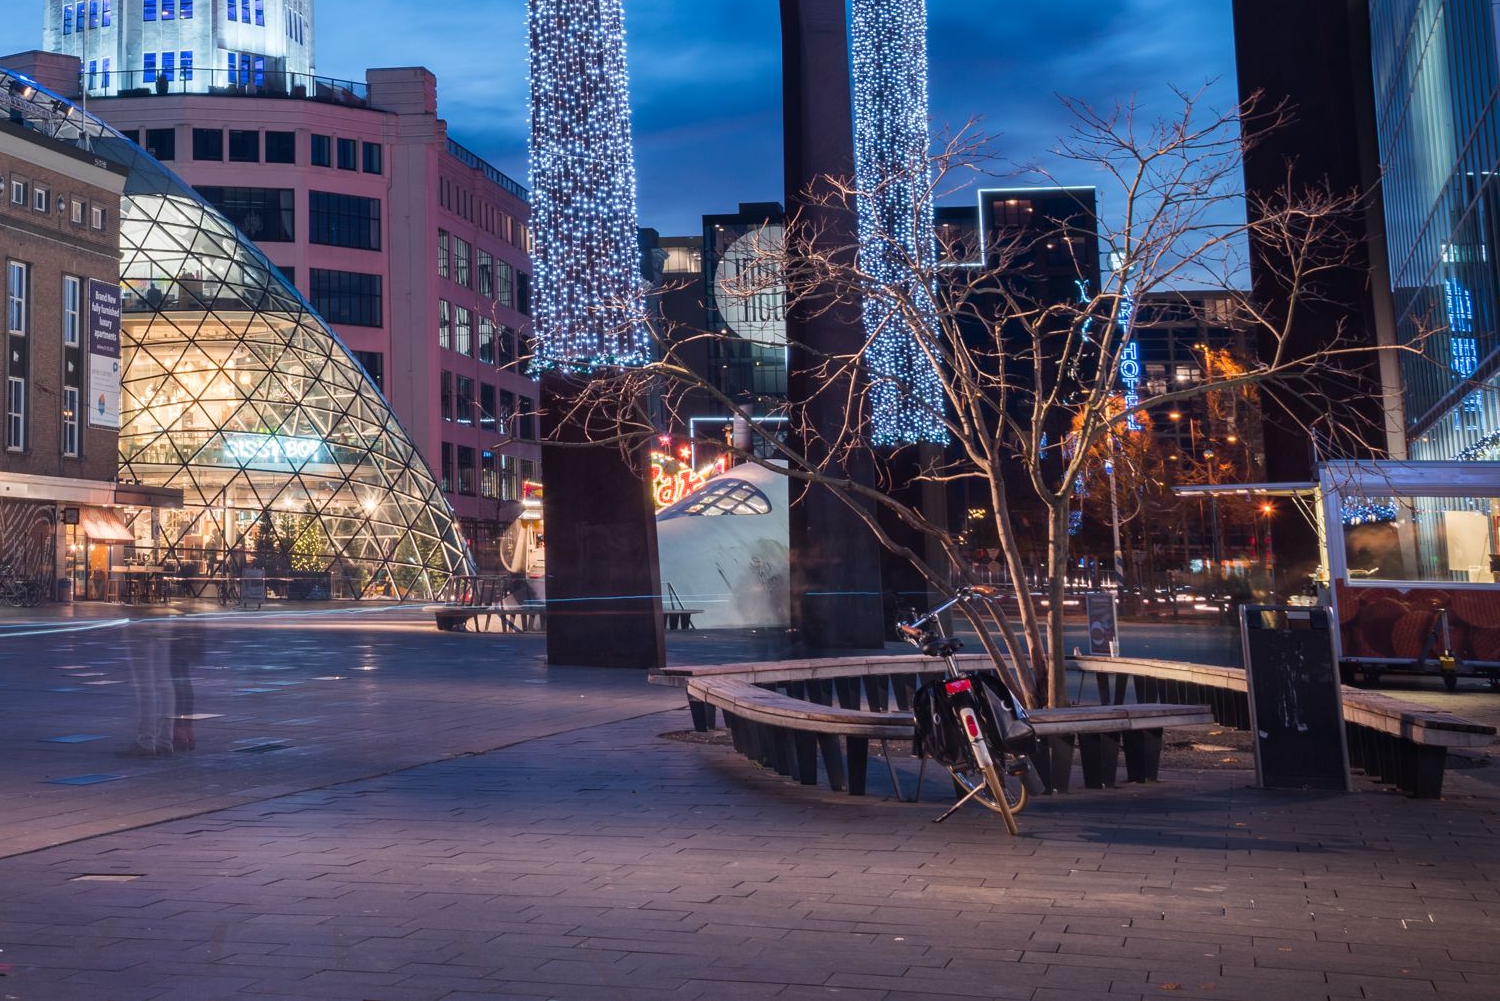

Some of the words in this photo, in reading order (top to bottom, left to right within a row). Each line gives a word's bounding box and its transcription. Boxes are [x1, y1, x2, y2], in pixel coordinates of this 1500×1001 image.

[95, 290, 107, 303] Brand
[108, 293, 116, 304] New
[92, 301, 101, 315] fully
[101, 304, 120, 317] furnished
[99, 316, 112, 330] luxury
[94, 330, 117, 341] apartments
[1120, 342, 1142, 430] HOTEL
[225, 440, 280, 463] SISSY
[283, 441, 320, 462] BOY
